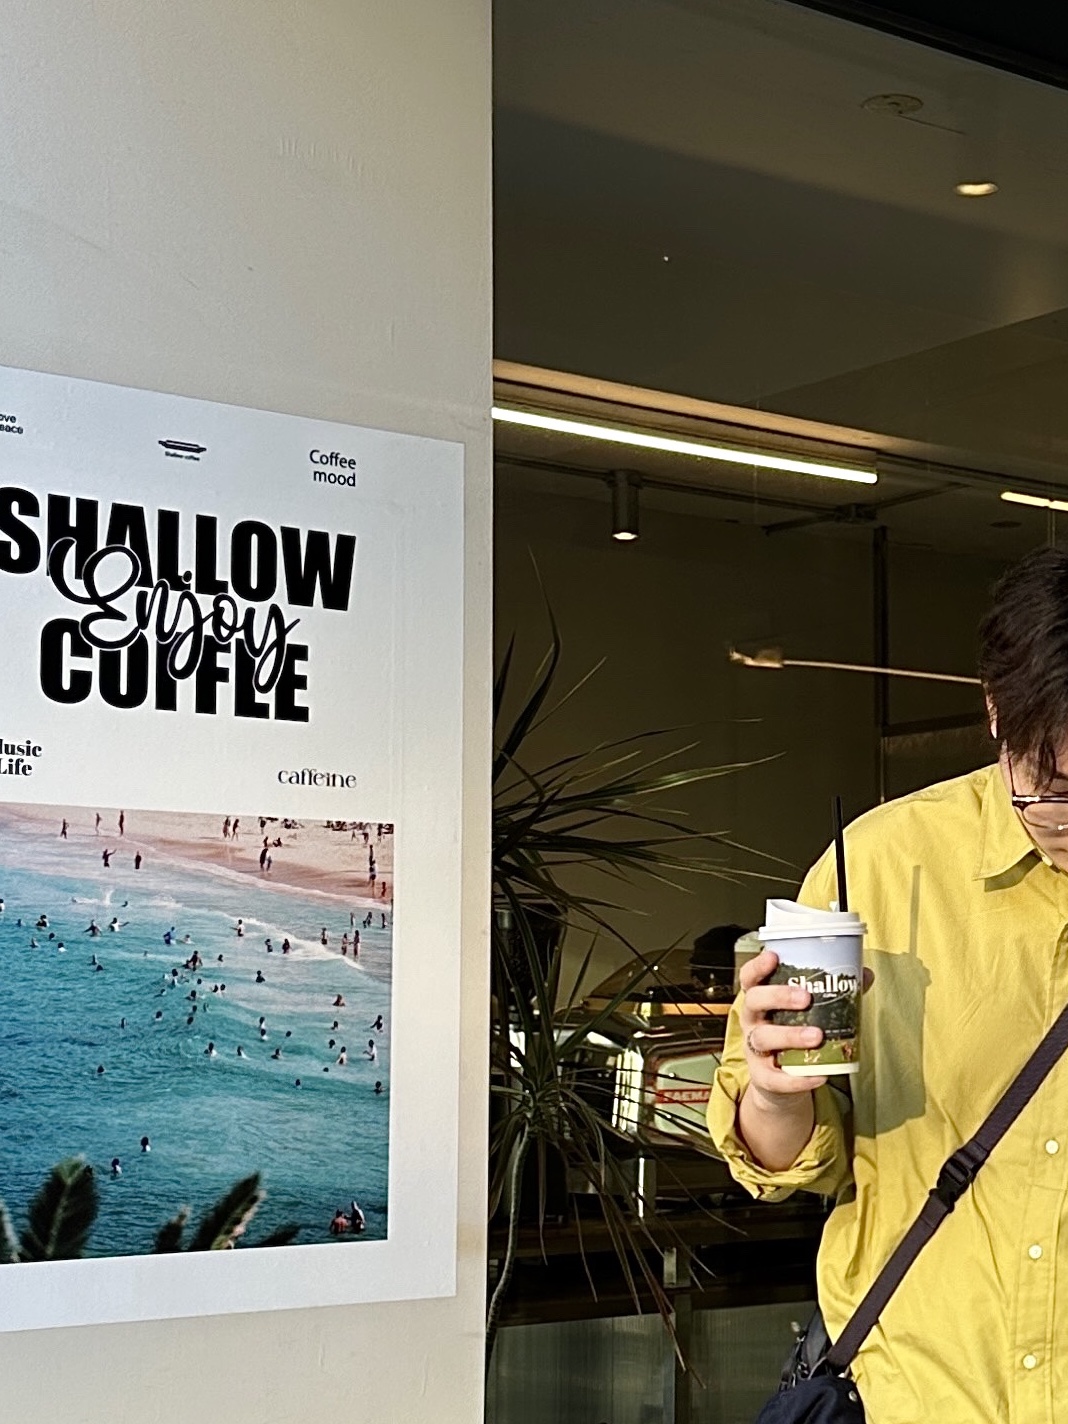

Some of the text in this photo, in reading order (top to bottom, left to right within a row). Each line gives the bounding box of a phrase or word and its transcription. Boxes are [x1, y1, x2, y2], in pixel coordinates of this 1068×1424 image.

[309, 449, 357, 469] Coffee
[313, 470, 356, 487] mood
[0, 487, 357, 612] SHALLOW
[48, 537, 301, 694] Enjoy
[277, 767, 358, 789] caffeine
